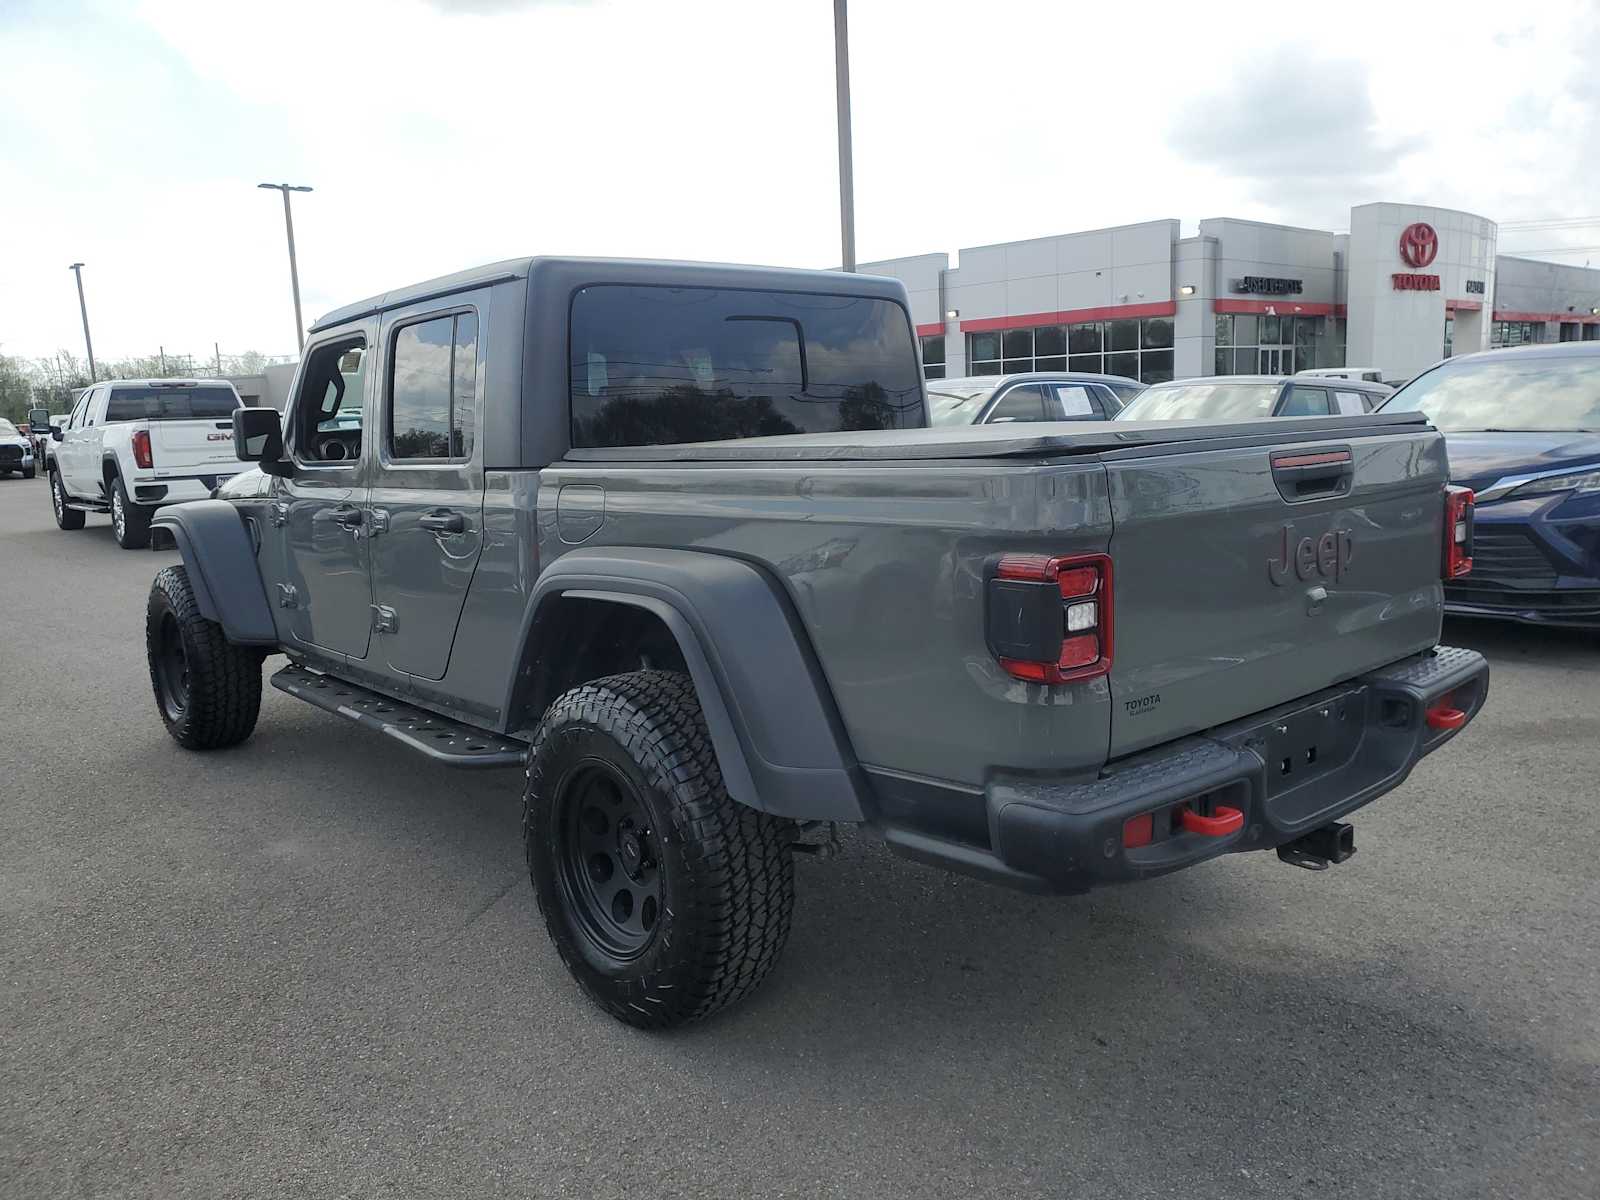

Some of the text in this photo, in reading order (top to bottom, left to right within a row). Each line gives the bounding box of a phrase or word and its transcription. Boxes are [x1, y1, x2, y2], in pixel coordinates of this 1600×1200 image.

[1392, 274, 1440, 291] TOYOTA
[207, 433, 232, 441] GM
[1267, 524, 1353, 587] Jeep
[1124, 694, 1161, 711] TOYOTA
